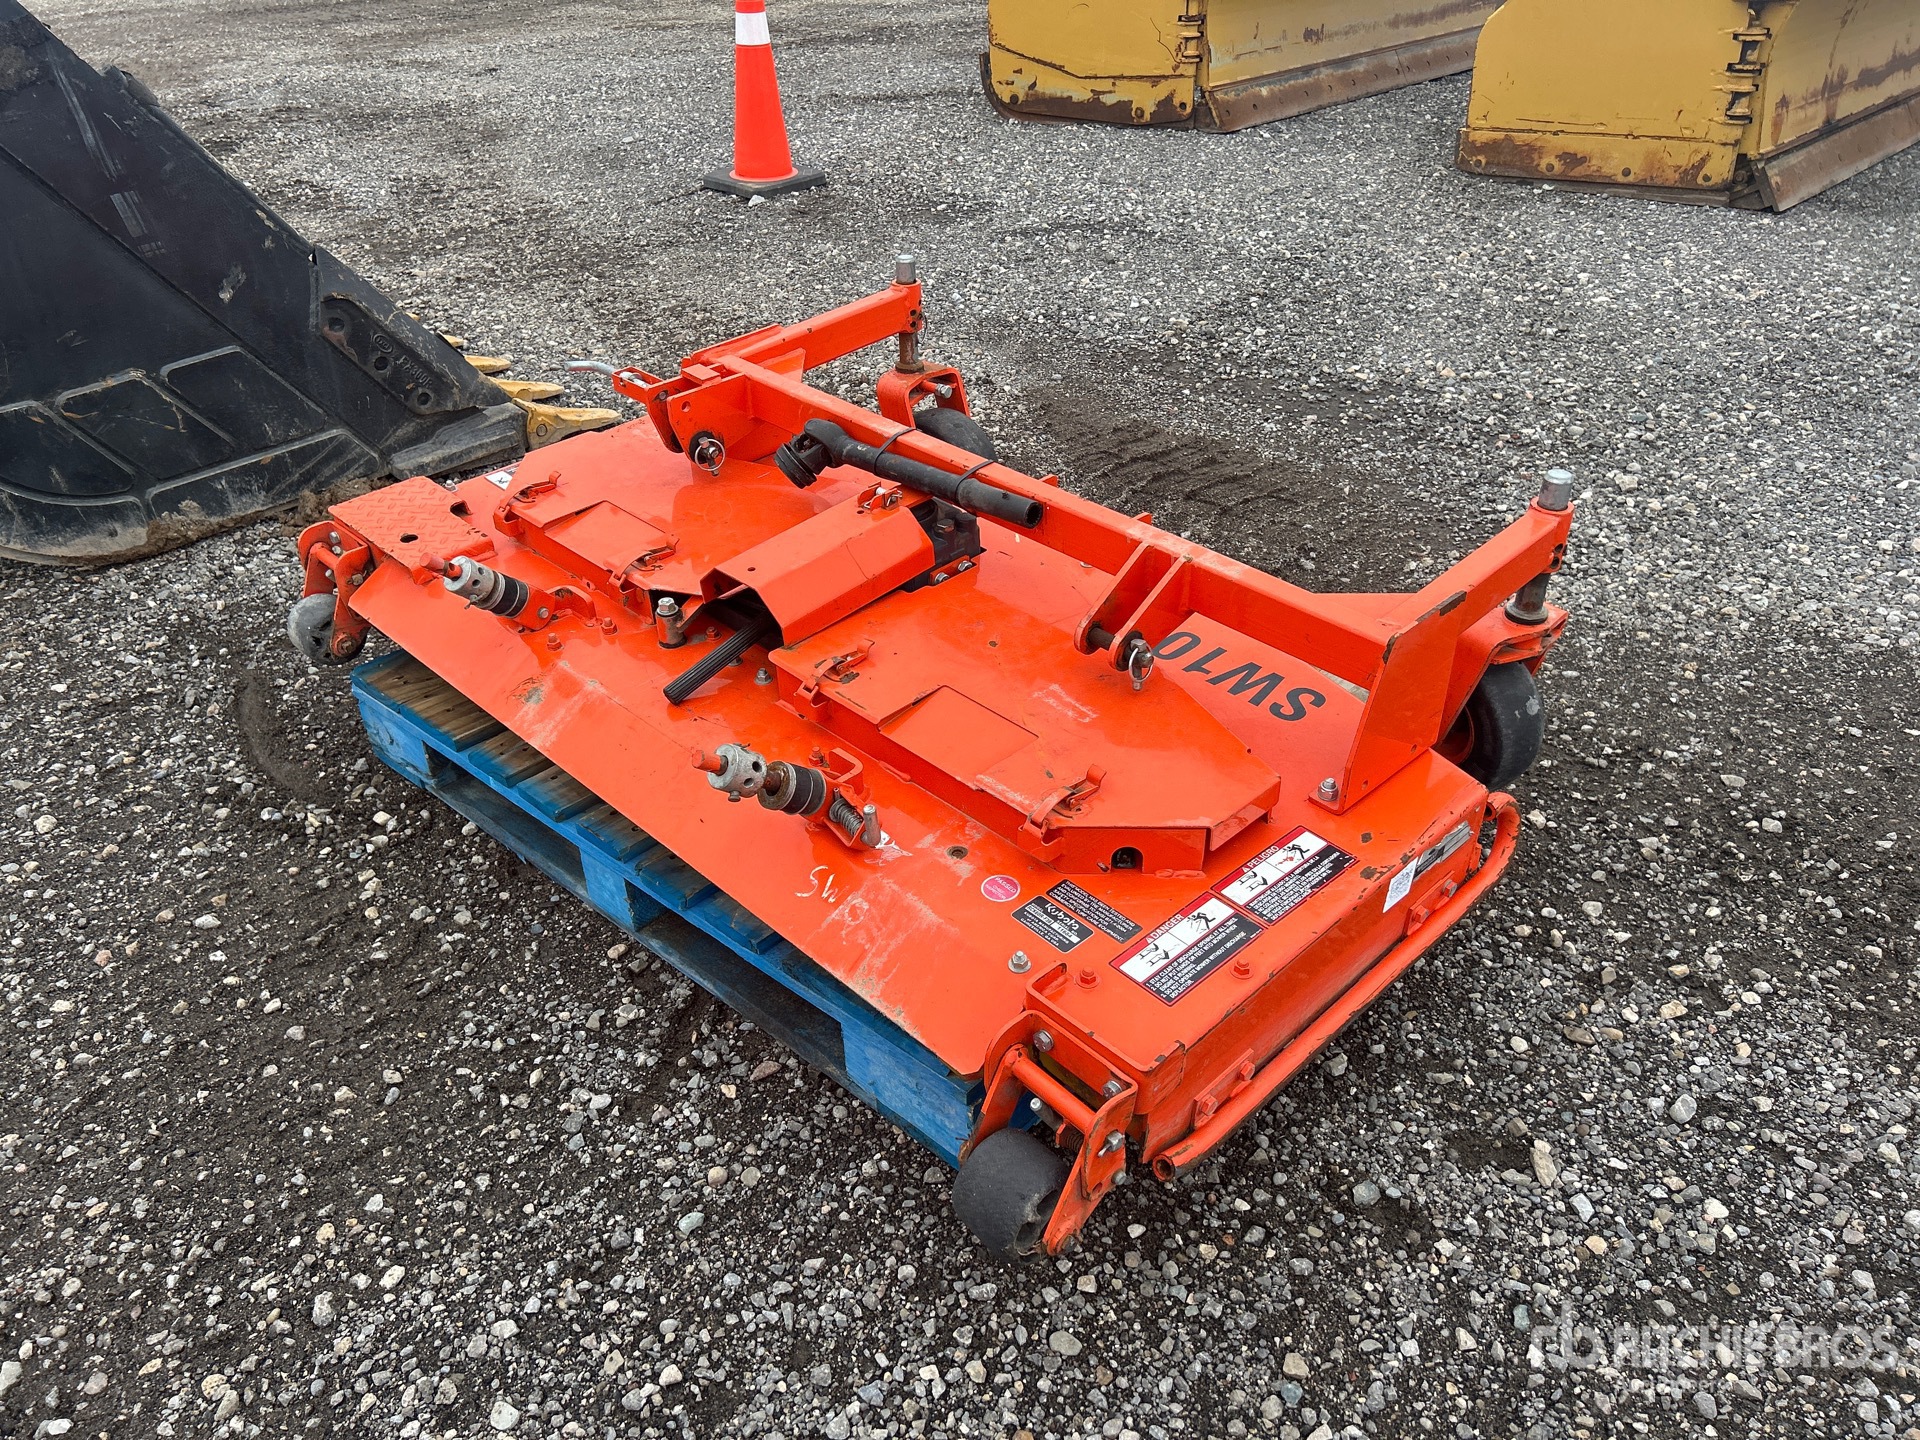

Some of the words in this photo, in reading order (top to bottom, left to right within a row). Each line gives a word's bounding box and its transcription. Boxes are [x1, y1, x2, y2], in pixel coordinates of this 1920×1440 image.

[1152, 631, 1327, 722] SW10
[1246, 844, 1280, 868] PELIGRO
[1042, 902, 1082, 930] Kubota
[1149, 912, 1185, 939] DANGER
[1158, 965, 1174, 977] CLEAR
[1159, 975, 1171, 983] NOT
[1167, 968, 1179, 977] PUT
[1175, 959, 1191, 971] HANDS
